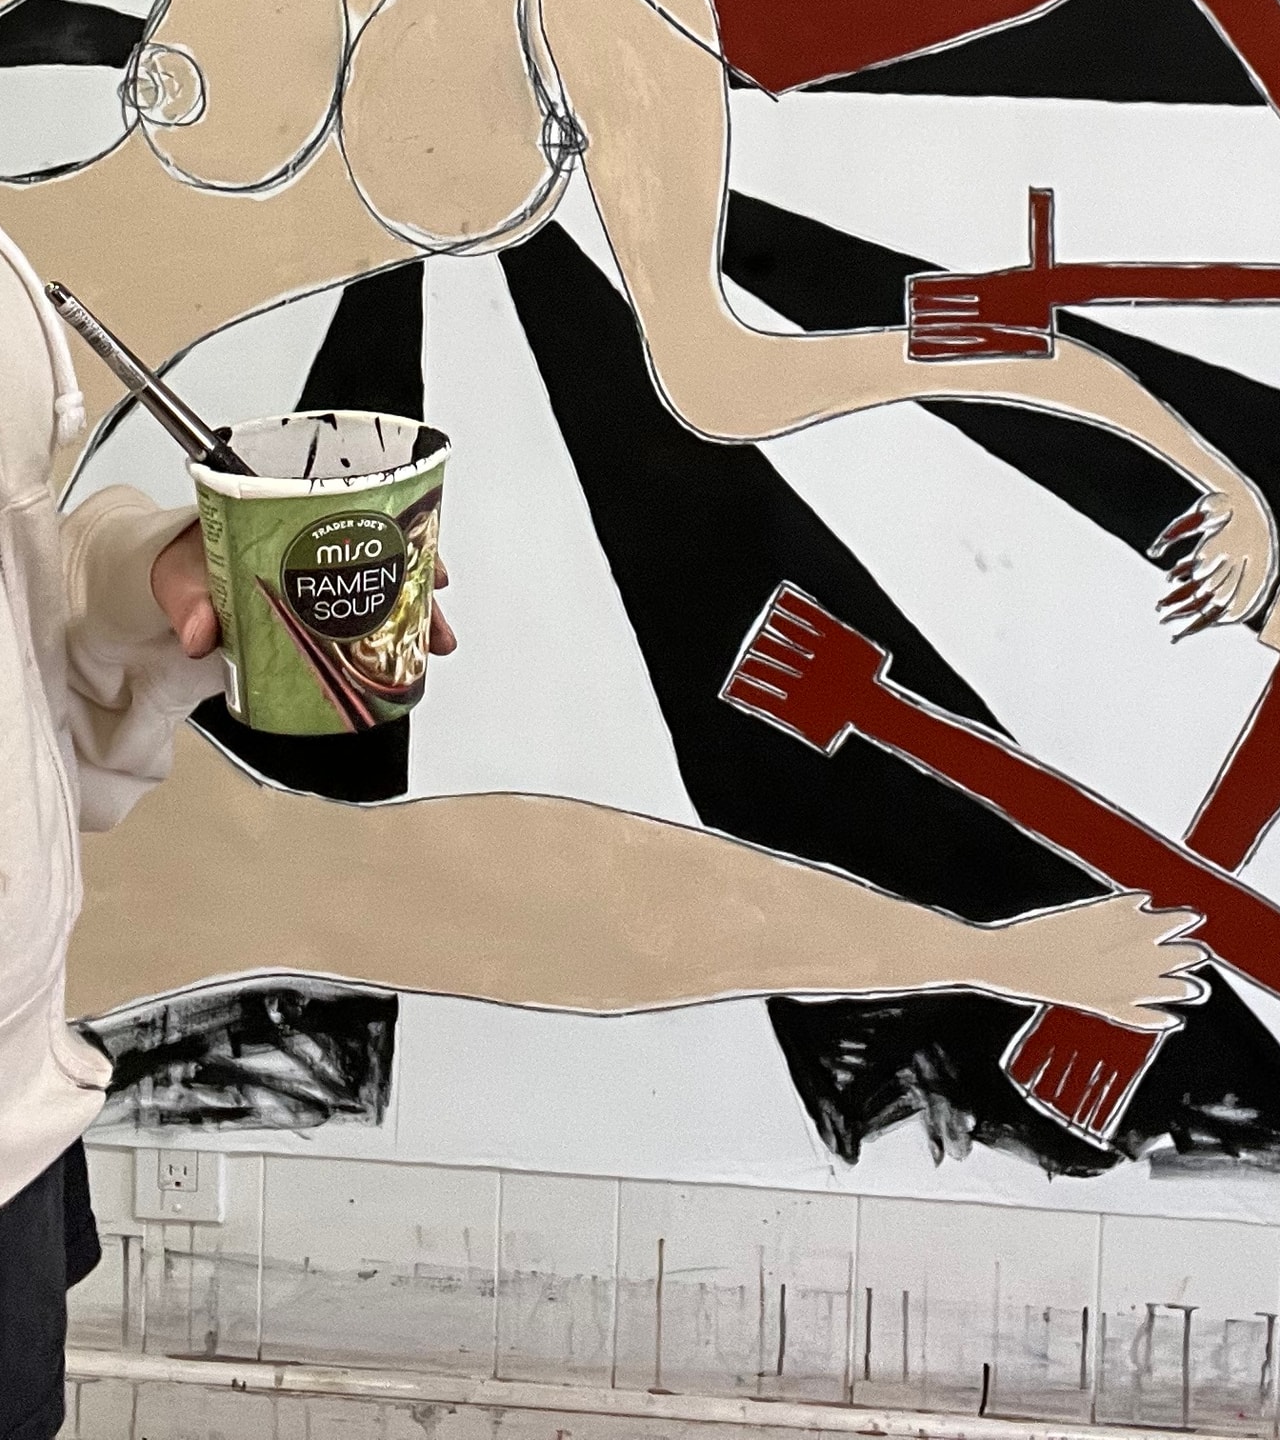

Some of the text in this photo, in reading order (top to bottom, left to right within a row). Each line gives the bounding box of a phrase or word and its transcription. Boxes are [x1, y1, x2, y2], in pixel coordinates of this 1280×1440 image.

[312, 519, 385, 539] TRADER JOE'S
[316, 538, 383, 564] miso
[297, 563, 396, 598] RAMEN
[314, 593, 385, 620] SOUP
